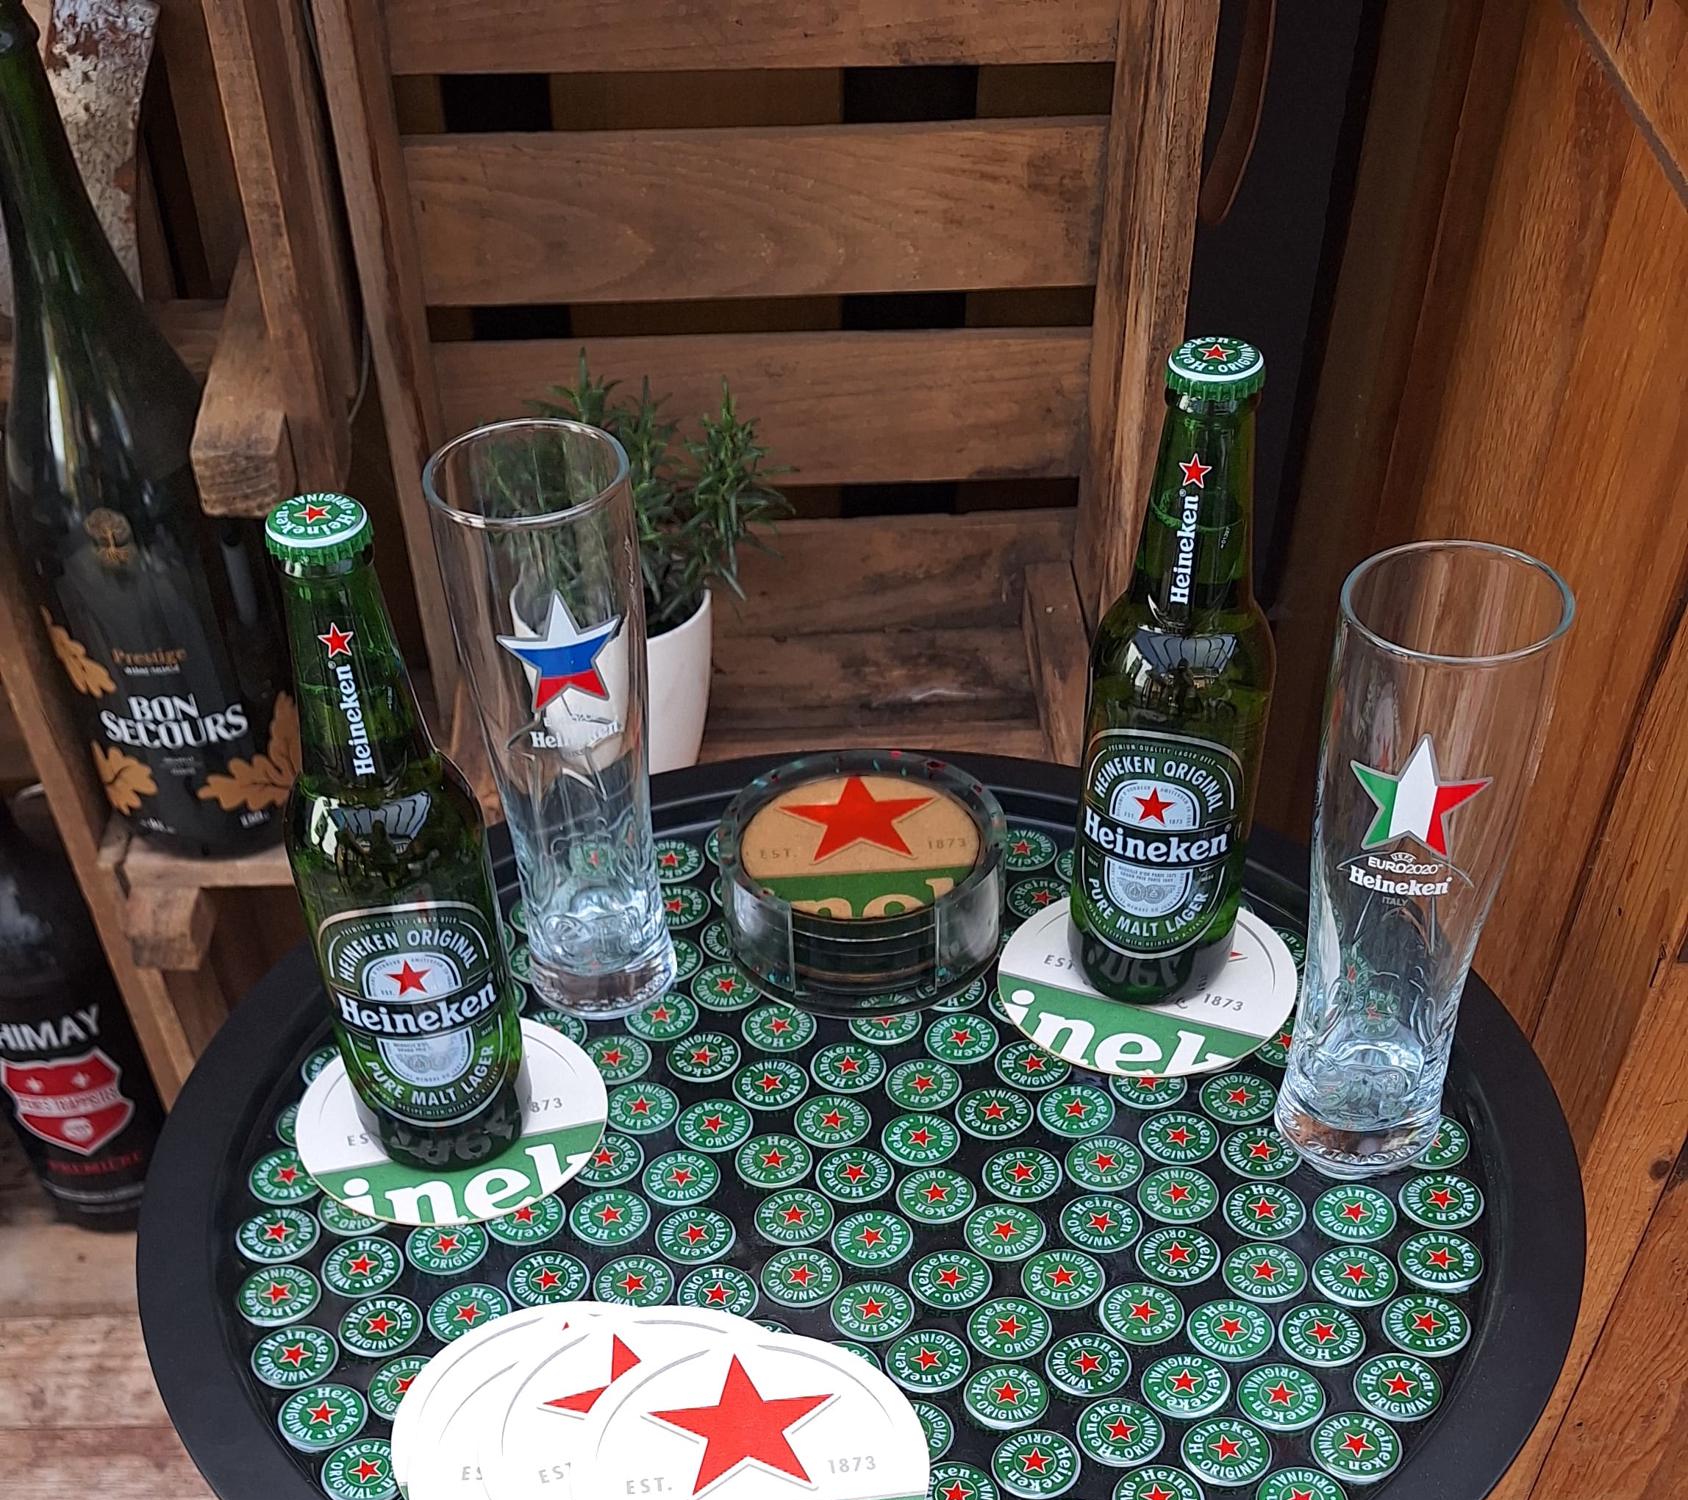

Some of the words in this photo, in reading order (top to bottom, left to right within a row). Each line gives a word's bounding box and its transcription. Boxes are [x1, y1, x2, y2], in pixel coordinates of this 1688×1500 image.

[1175, 336, 1229, 372] Heineken
[1217, 342, 1257, 373] ORIGINAL
[286, 493, 357, 511] ORIGINAL
[275, 509, 357, 535] Heineken
[1169, 494, 1199, 606] Heineken
[111, 648, 188, 665] Prestige
[127, 692, 200, 721] BON
[336, 663, 377, 777] Heineken
[100, 704, 249, 750] SECOURS
[1093, 755, 1156, 799] HEINEKEN
[1163, 760, 1224, 814] ORIGINAL
[927, 837, 967, 850] 1873
[1084, 805, 1228, 863] Heineken
[1348, 864, 1450, 897] Heineken
[1367, 855, 1439, 875] EURO2020
[1088, 877, 1115, 920] PURE
[1115, 915, 1159, 937] MALT
[1164, 891, 1210, 933] LAGER
[1381, 896, 1410, 908] ITALY
[339, 932, 400, 983] HEINEKEN
[406, 928, 479, 970] ORIGINAL
[336, 982, 498, 1034] Heineken
[1203, 992, 1246, 1012] 1873
[748, 1004, 785, 1048] Heineken
[950, 1015, 993, 1058] Heineken
[365, 1061, 406, 1100] PURE
[411, 1087, 459, 1107] MALT
[460, 1044, 495, 1095] LAGER
[530, 1097, 563, 1114] 873
[681, 1101, 738, 1143] Heineken
[1041, 1088, 1071, 1131] ORIGINAL
[1068, 1085, 1109, 1132] Heineken
[702, 1114, 748, 1149] ORIGINAL
[1143, 1136, 1204, 1161] ORIGINAL
[1145, 1113, 1213, 1147] Heineken
[647, 1154, 710, 1192] Heineken
[662, 1171, 716, 1202] ORIGINAL
[822, 1150, 865, 1198] Heineken
[859, 1149, 891, 1193] ORIGINAL
[989, 1149, 1028, 1198] Heineken
[1030, 1152, 1059, 1197] ORIGINAL
[1151, 1167, 1215, 1192] ORIGINAL
[758, 1192, 828, 1218] Heineken
[910, 1174, 971, 1217] Heineken
[1144, 1184, 1214, 1218] Heineken
[1226, 1189, 1264, 1235] ORIGINAL
[1248, 1183, 1299, 1234] Heineken
[1319, 1187, 1390, 1226] Heineken
[1403, 1171, 1435, 1217] ORIGINAL
[1433, 1172, 1477, 1222] Heineken
[577, 1191, 618, 1241] Heineken
[617, 1193, 647, 1240] ORIGINAL
[760, 1222, 825, 1242] ORIGINAL
[969, 1206, 1031, 1249] Heineken
[1063, 1218, 1122, 1248] ORIGINAL
[1068, 1196, 1135, 1236] Heineken
[1316, 1208, 1377, 1238] ORIGINAL
[990, 1223, 1040, 1257] ORIGINAL
[1403, 1233, 1477, 1271] Heineken
[324, 1244, 354, 1290] ORIGINAL
[357, 1239, 396, 1290] Heineken
[765, 1251, 835, 1285] Heineken
[915, 1253, 976, 1298] Heineken
[1041, 1250, 1101, 1281] ORIGINAL
[1227, 1246, 1301, 1279] Heineken
[1321, 1247, 1391, 1291] Heineken
[1401, 1256, 1468, 1284] ORIGINAL
[763, 1278, 827, 1303] ORIGINAL
[938, 1268, 987, 1305] ORIGINAL
[1028, 1262, 1096, 1302] Heineken
[1227, 1274, 1296, 1298] ORIGINAL
[1316, 1266, 1377, 1300] ORIGINAL
[342, 1298, 415, 1331] Heineken
[973, 1301, 1033, 1350] Heineken
[1104, 1285, 1134, 1334] ORIGINAL
[1139, 1284, 1178, 1337] Heineken
[1199, 1300, 1267, 1347] Heineken
[1386, 1294, 1417, 1345] ORIGINAL
[1423, 1294, 1463, 1349] Heineken
[259, 1328, 331, 1366] Heineken
[341, 1328, 407, 1352] ORIGINAL
[900, 1331, 966, 1358] ORIGINAL
[1000, 1315, 1047, 1356] ORIGINAL
[1191, 1318, 1248, 1356] ORIGINAL
[1286, 1305, 1332, 1361] Heineken
[1330, 1307, 1364, 1359] ORIGINAL
[255, 1356, 318, 1383] ORIGINAL
[892, 1348, 965, 1385] Heineken
[1048, 1347, 1096, 1391] ORIGINAL
[1063, 1335, 1124, 1386] Heineken
[1146, 1351, 1207, 1385] ORIGINAL
[1242, 1364, 1306, 1394] ORIGINAL
[1359, 1358, 1438, 1392] Heineken
[968, 1367, 1044, 1398] Heineken
[1152, 1366, 1224, 1409] Heineken
[1247, 1381, 1320, 1422] Heineken
[282, 1391, 316, 1441] ORIGINAL
[315, 1385, 360, 1441] Heineken
[971, 1399, 1041, 1423] ORIGINAL
[1362, 1391, 1435, 1416] ORIGINAL
[997, 1430, 1058, 1465] ORIGINAL
[1083, 1402, 1136, 1459] Heineken
[1122, 1411, 1161, 1462] ORIGINAL
[1186, 1420, 1265, 1455] Heineken
[1315, 1413, 1352, 1464] ORIGINAL
[1345, 1416, 1395, 1472] Heineken
[626, 1476, 673, 1495] EST.
[827, 1455, 877, 1474] 1873
[1002, 1445, 1074, 1490] Heineken
[1194, 1454, 1265, 1480] ORIGINAL
[1267, 1469, 1342, 1496] ORIGINAL
